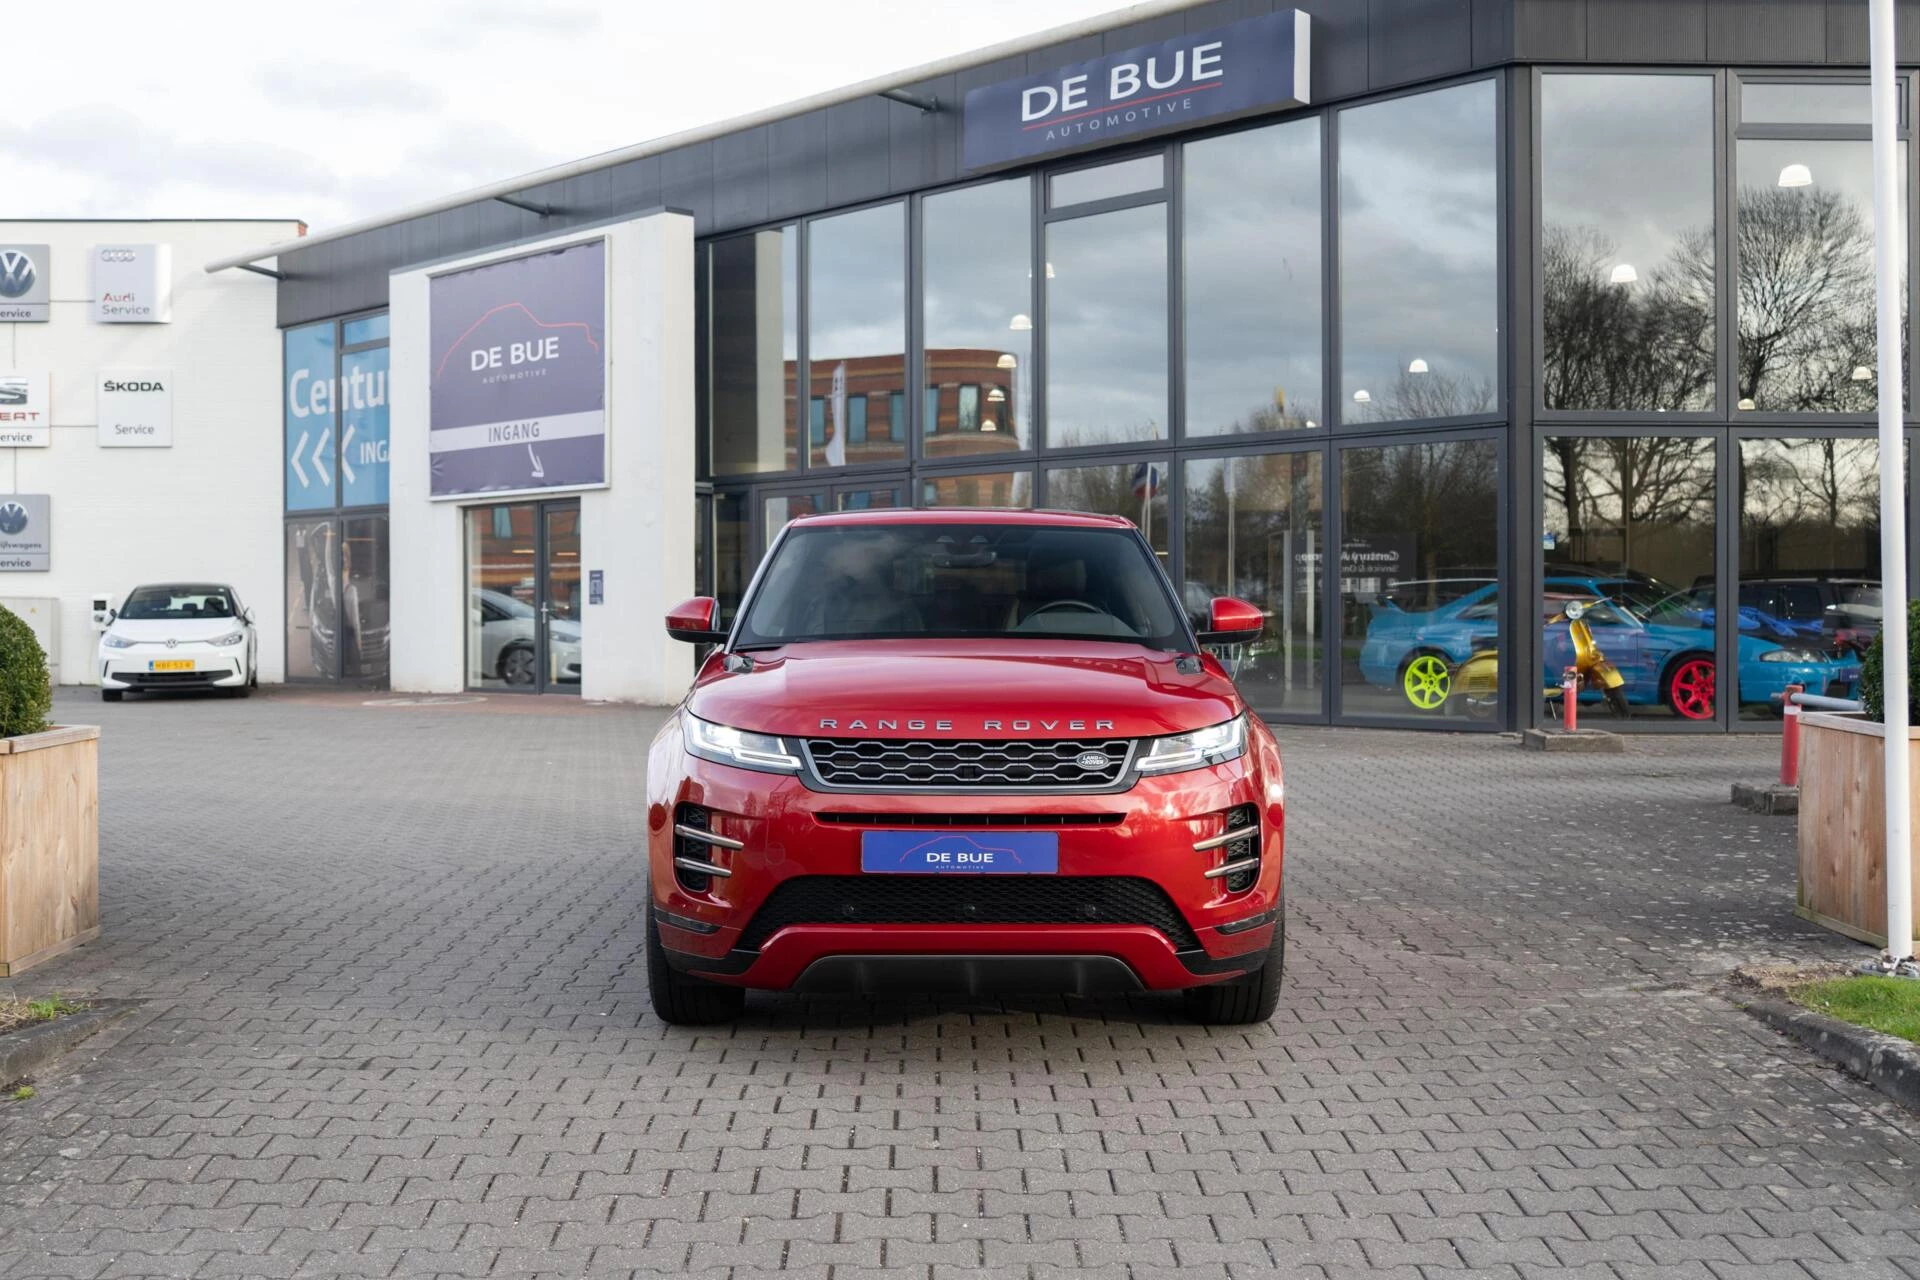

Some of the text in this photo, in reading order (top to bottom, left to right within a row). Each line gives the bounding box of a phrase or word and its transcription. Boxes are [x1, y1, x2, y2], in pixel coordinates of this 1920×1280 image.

[1021, 41, 1223, 122] DE BUE
[1045, 98, 1192, 140] AUTOMOTIVE
[103, 292, 135, 302] Audi
[0, 308, 32, 318] ervice
[102, 304, 150, 315] Service
[471, 336, 559, 371] DE BUE
[482, 368, 546, 384] AUTOMOTIVE
[104, 380, 165, 392] ŠKODA
[290, 365, 390, 418] Centu
[0, 412, 41, 421] EAT
[115, 424, 154, 435] Service
[488, 421, 540, 443] INGANG
[0, 432, 33, 442] ervice
[360, 440, 390, 464] ING
[0, 556, 32, 567] ervice
[820, 719, 1115, 730] RANGE ROVER
[926, 852, 994, 863] DE BUE
